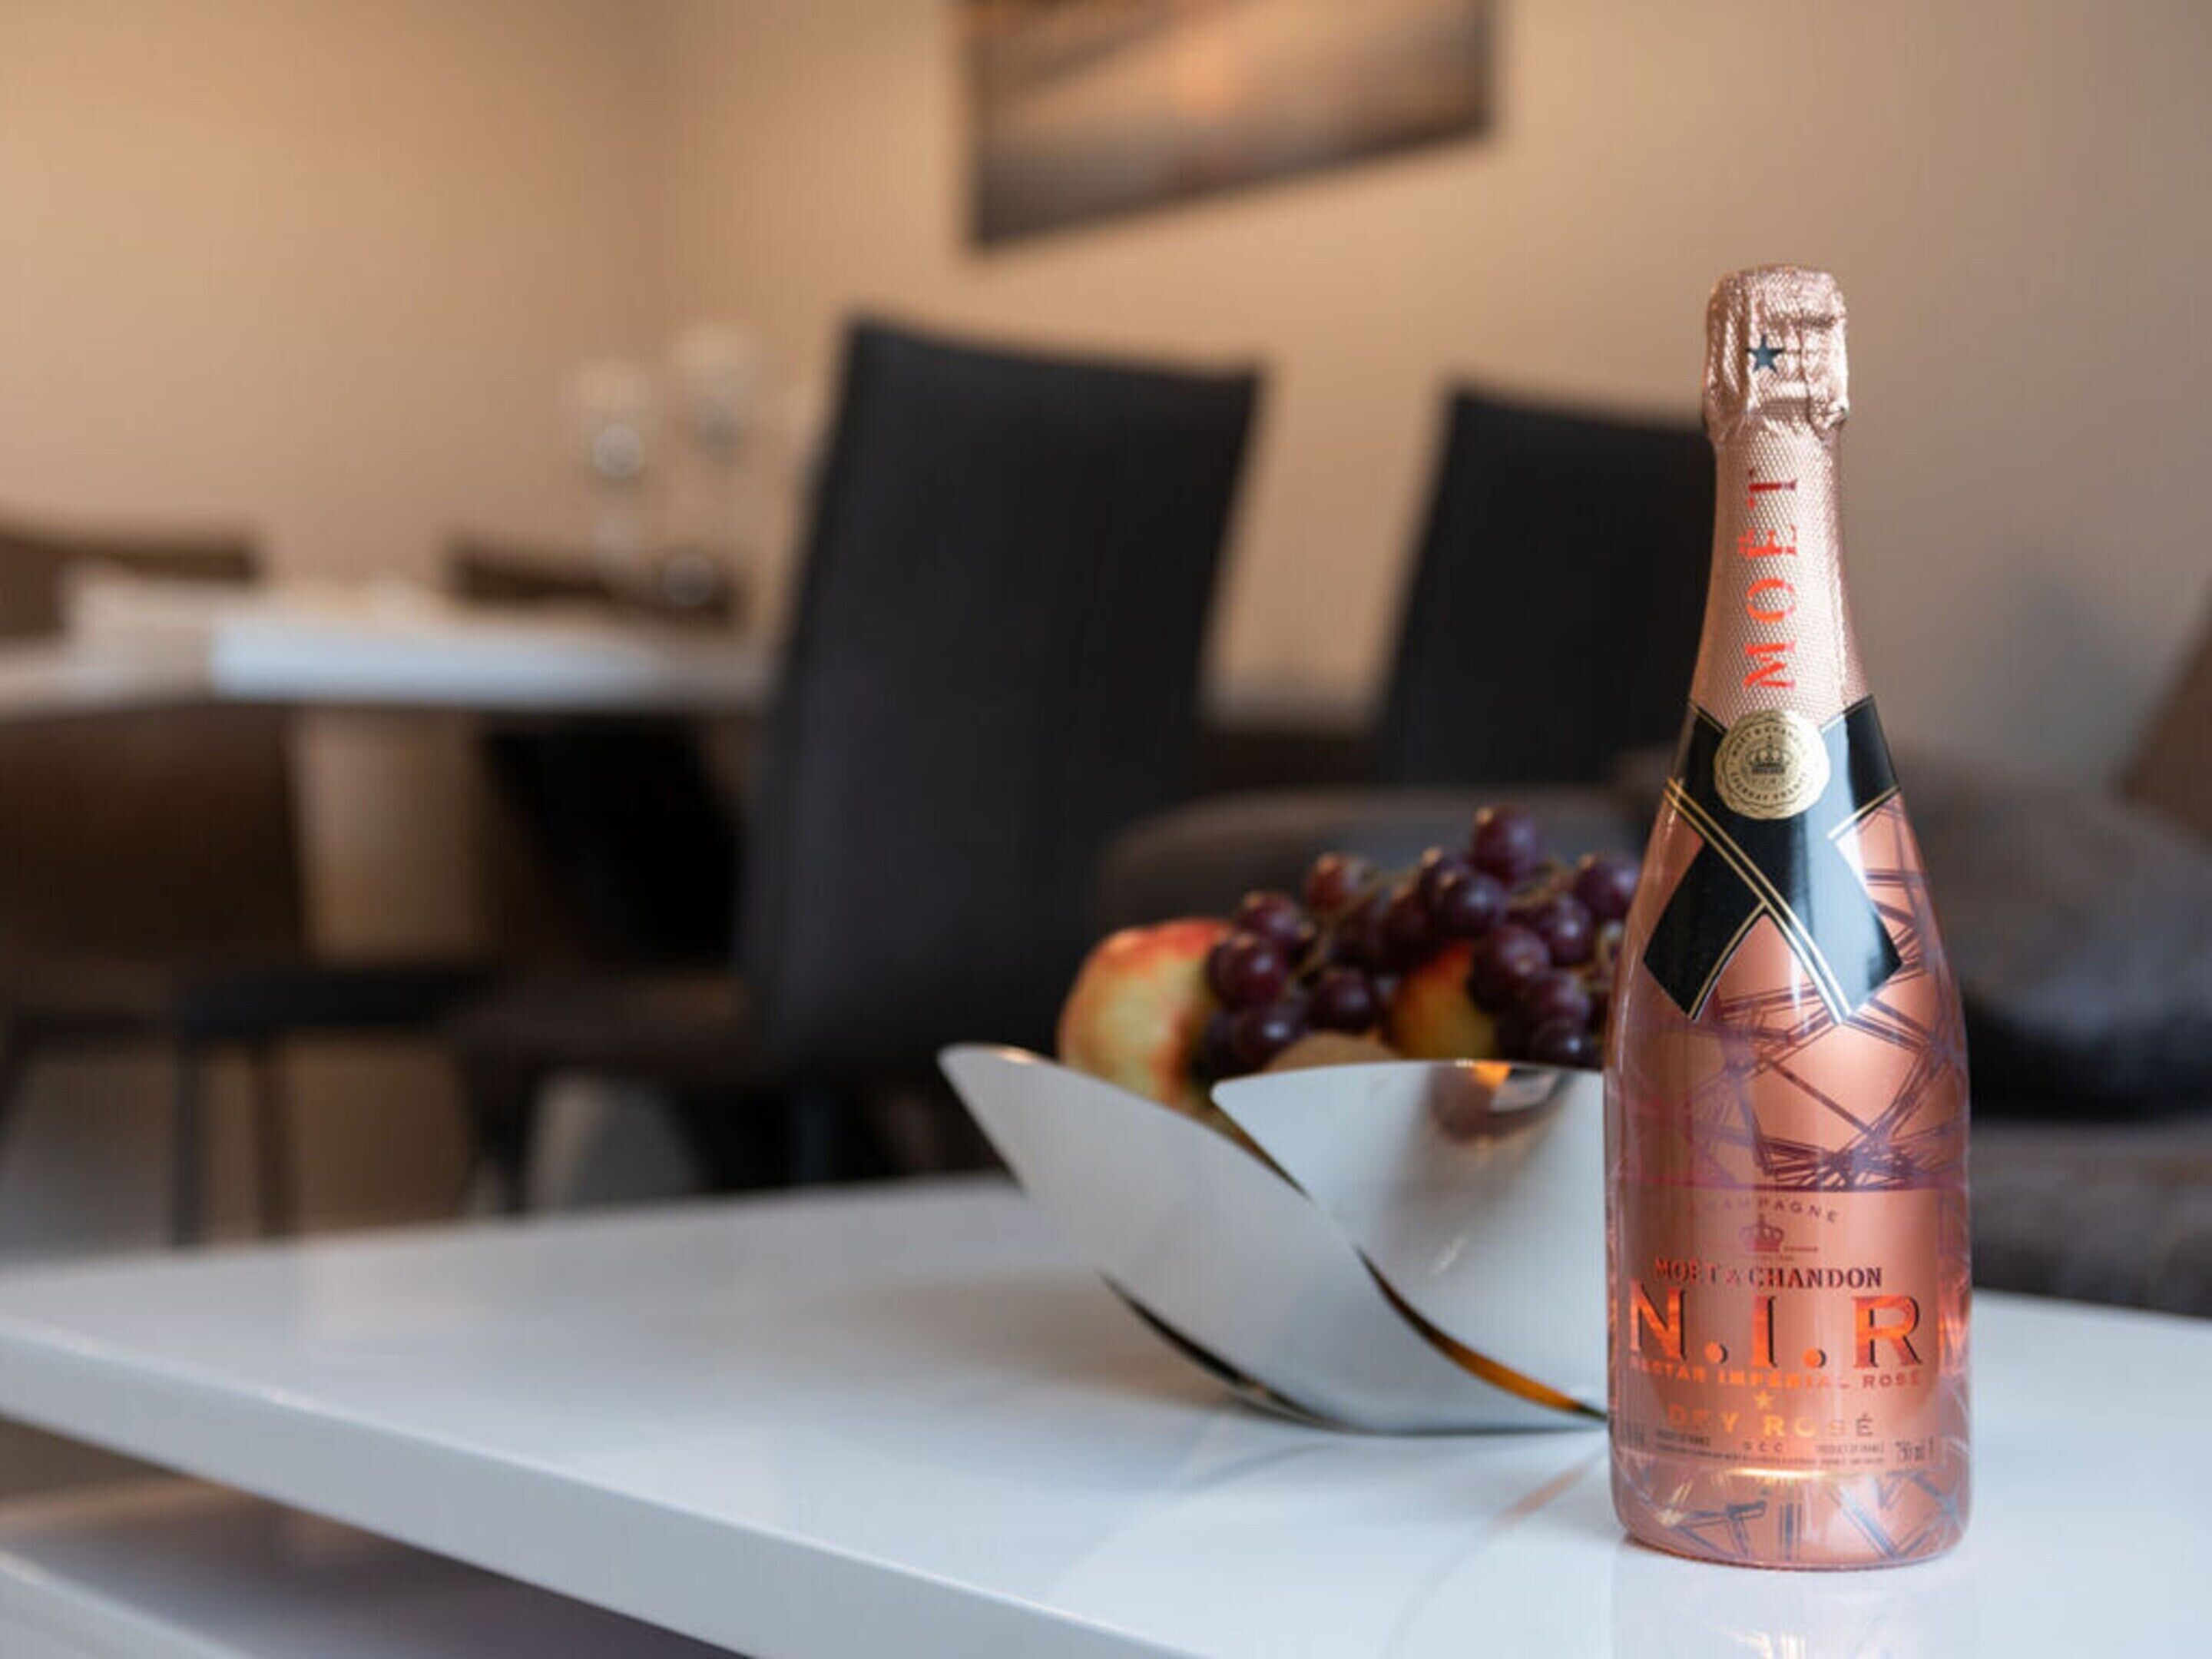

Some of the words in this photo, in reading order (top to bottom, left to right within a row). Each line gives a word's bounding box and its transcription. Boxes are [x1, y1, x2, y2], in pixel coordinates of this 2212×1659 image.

[1690, 1197, 1839, 1224] HAMPAGNE
[1748, 1267, 1882, 1289] CHANDON
[1763, 1412, 1873, 1438] ROSÉ
